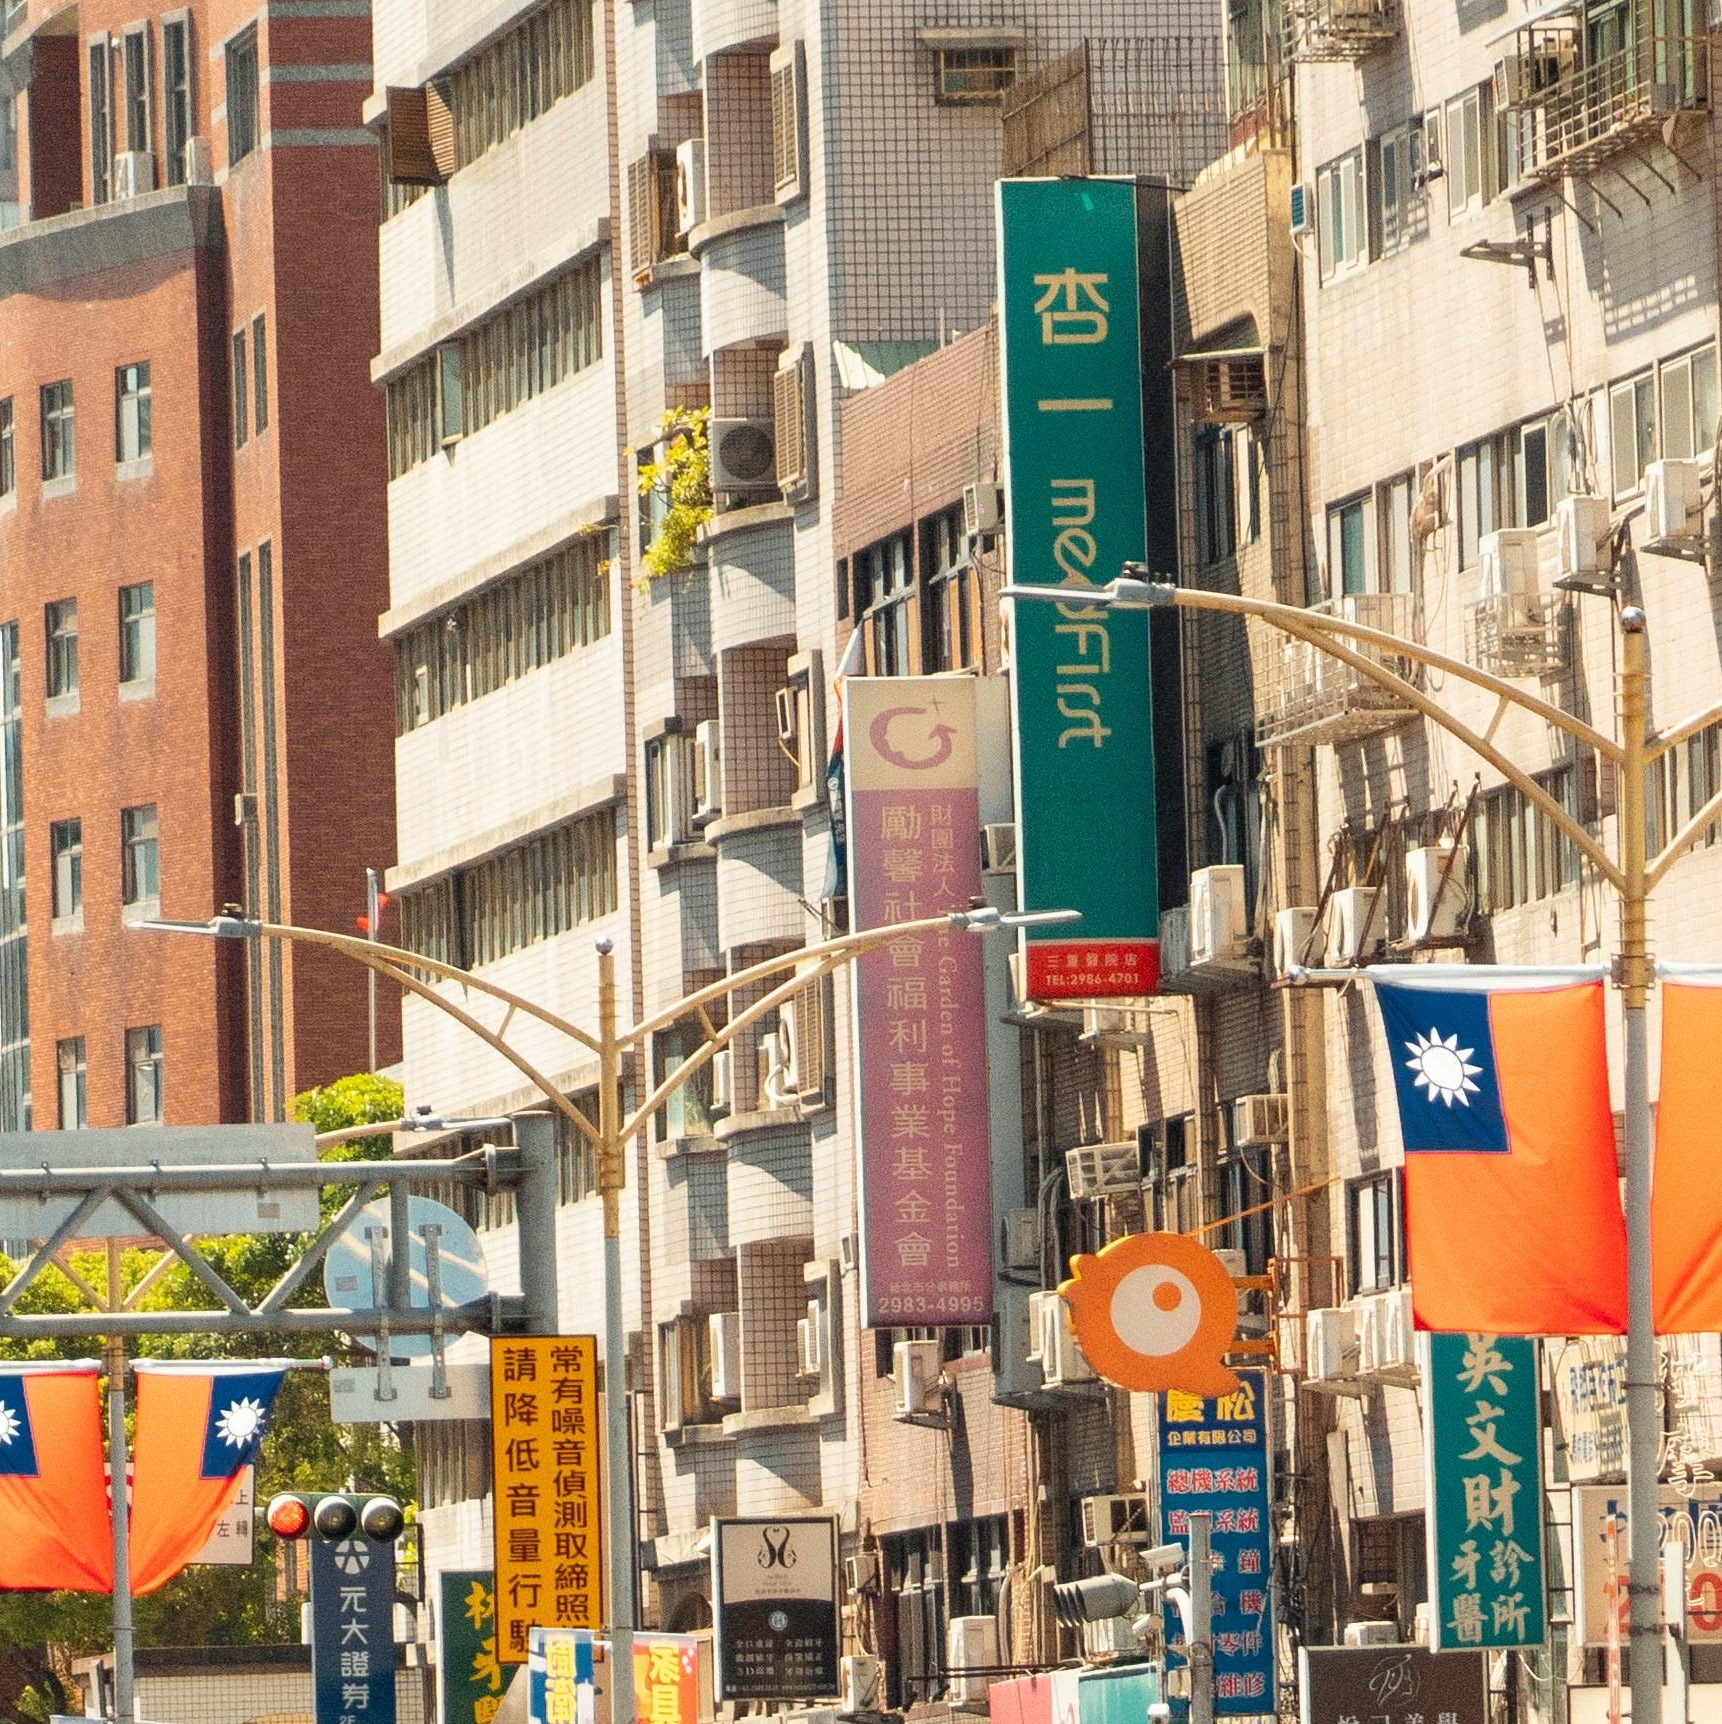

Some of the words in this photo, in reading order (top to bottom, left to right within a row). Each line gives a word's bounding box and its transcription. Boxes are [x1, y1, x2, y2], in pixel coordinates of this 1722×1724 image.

[1034, 267, 1113, 411] 杏一
[938, 956, 960, 1033] Garden
[938, 1075, 962, 1135] Hope
[943, 1143, 966, 1268] Foundation
[550, 1345, 590, 1627] 常有噪音偵測取締照
[1167, 1508, 1260, 1536] 監系統
[339, 1585, 371, 1710] 元大證券
